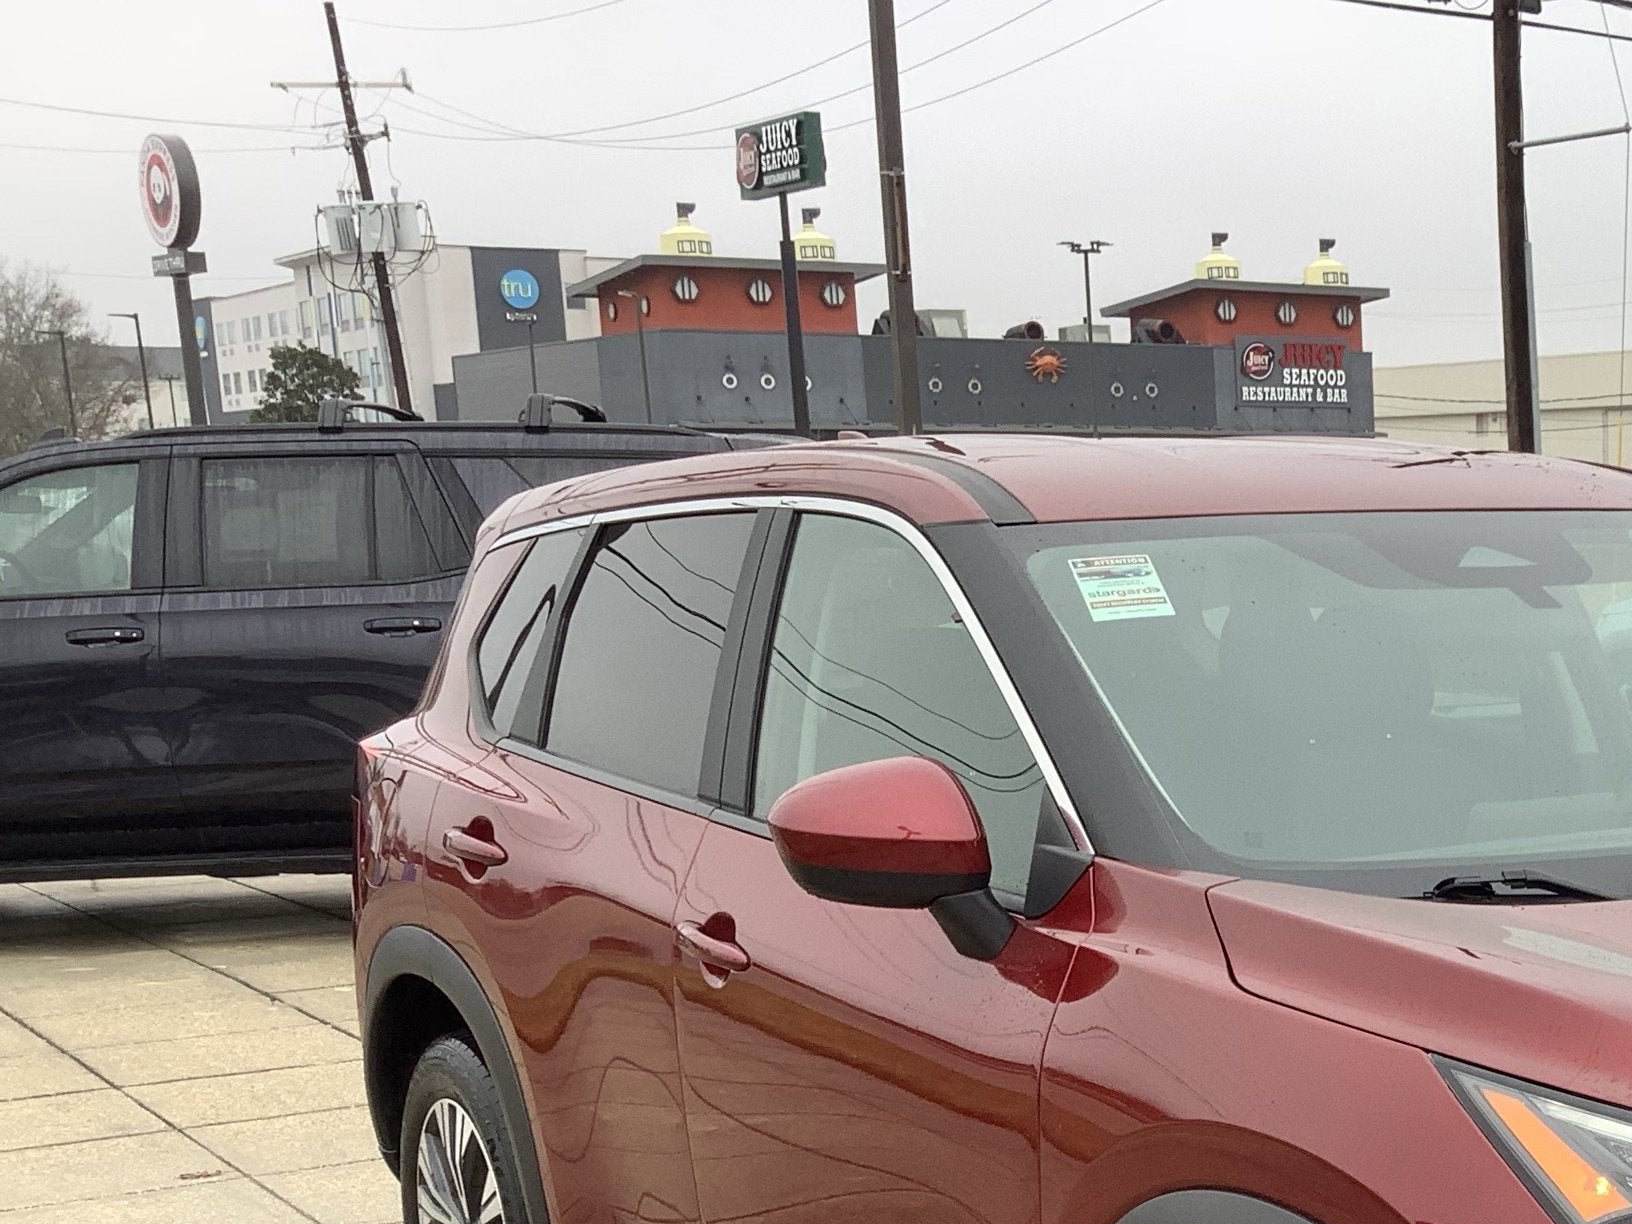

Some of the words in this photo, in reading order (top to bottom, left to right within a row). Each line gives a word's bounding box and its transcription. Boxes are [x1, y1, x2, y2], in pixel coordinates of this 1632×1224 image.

[760, 118, 798, 153] JUICY
[760, 147, 800, 173] SEAFOOD
[501, 278, 531, 298] tru
[1279, 343, 1346, 369] JUICY
[1283, 367, 1346, 386] SEAFOOD
[1242, 386, 1313, 401] RESTAURANT
[1316, 387, 1324, 402] &
[1326, 388, 1348, 403] BAR
[1093, 557, 1146, 567] ATTENTION
